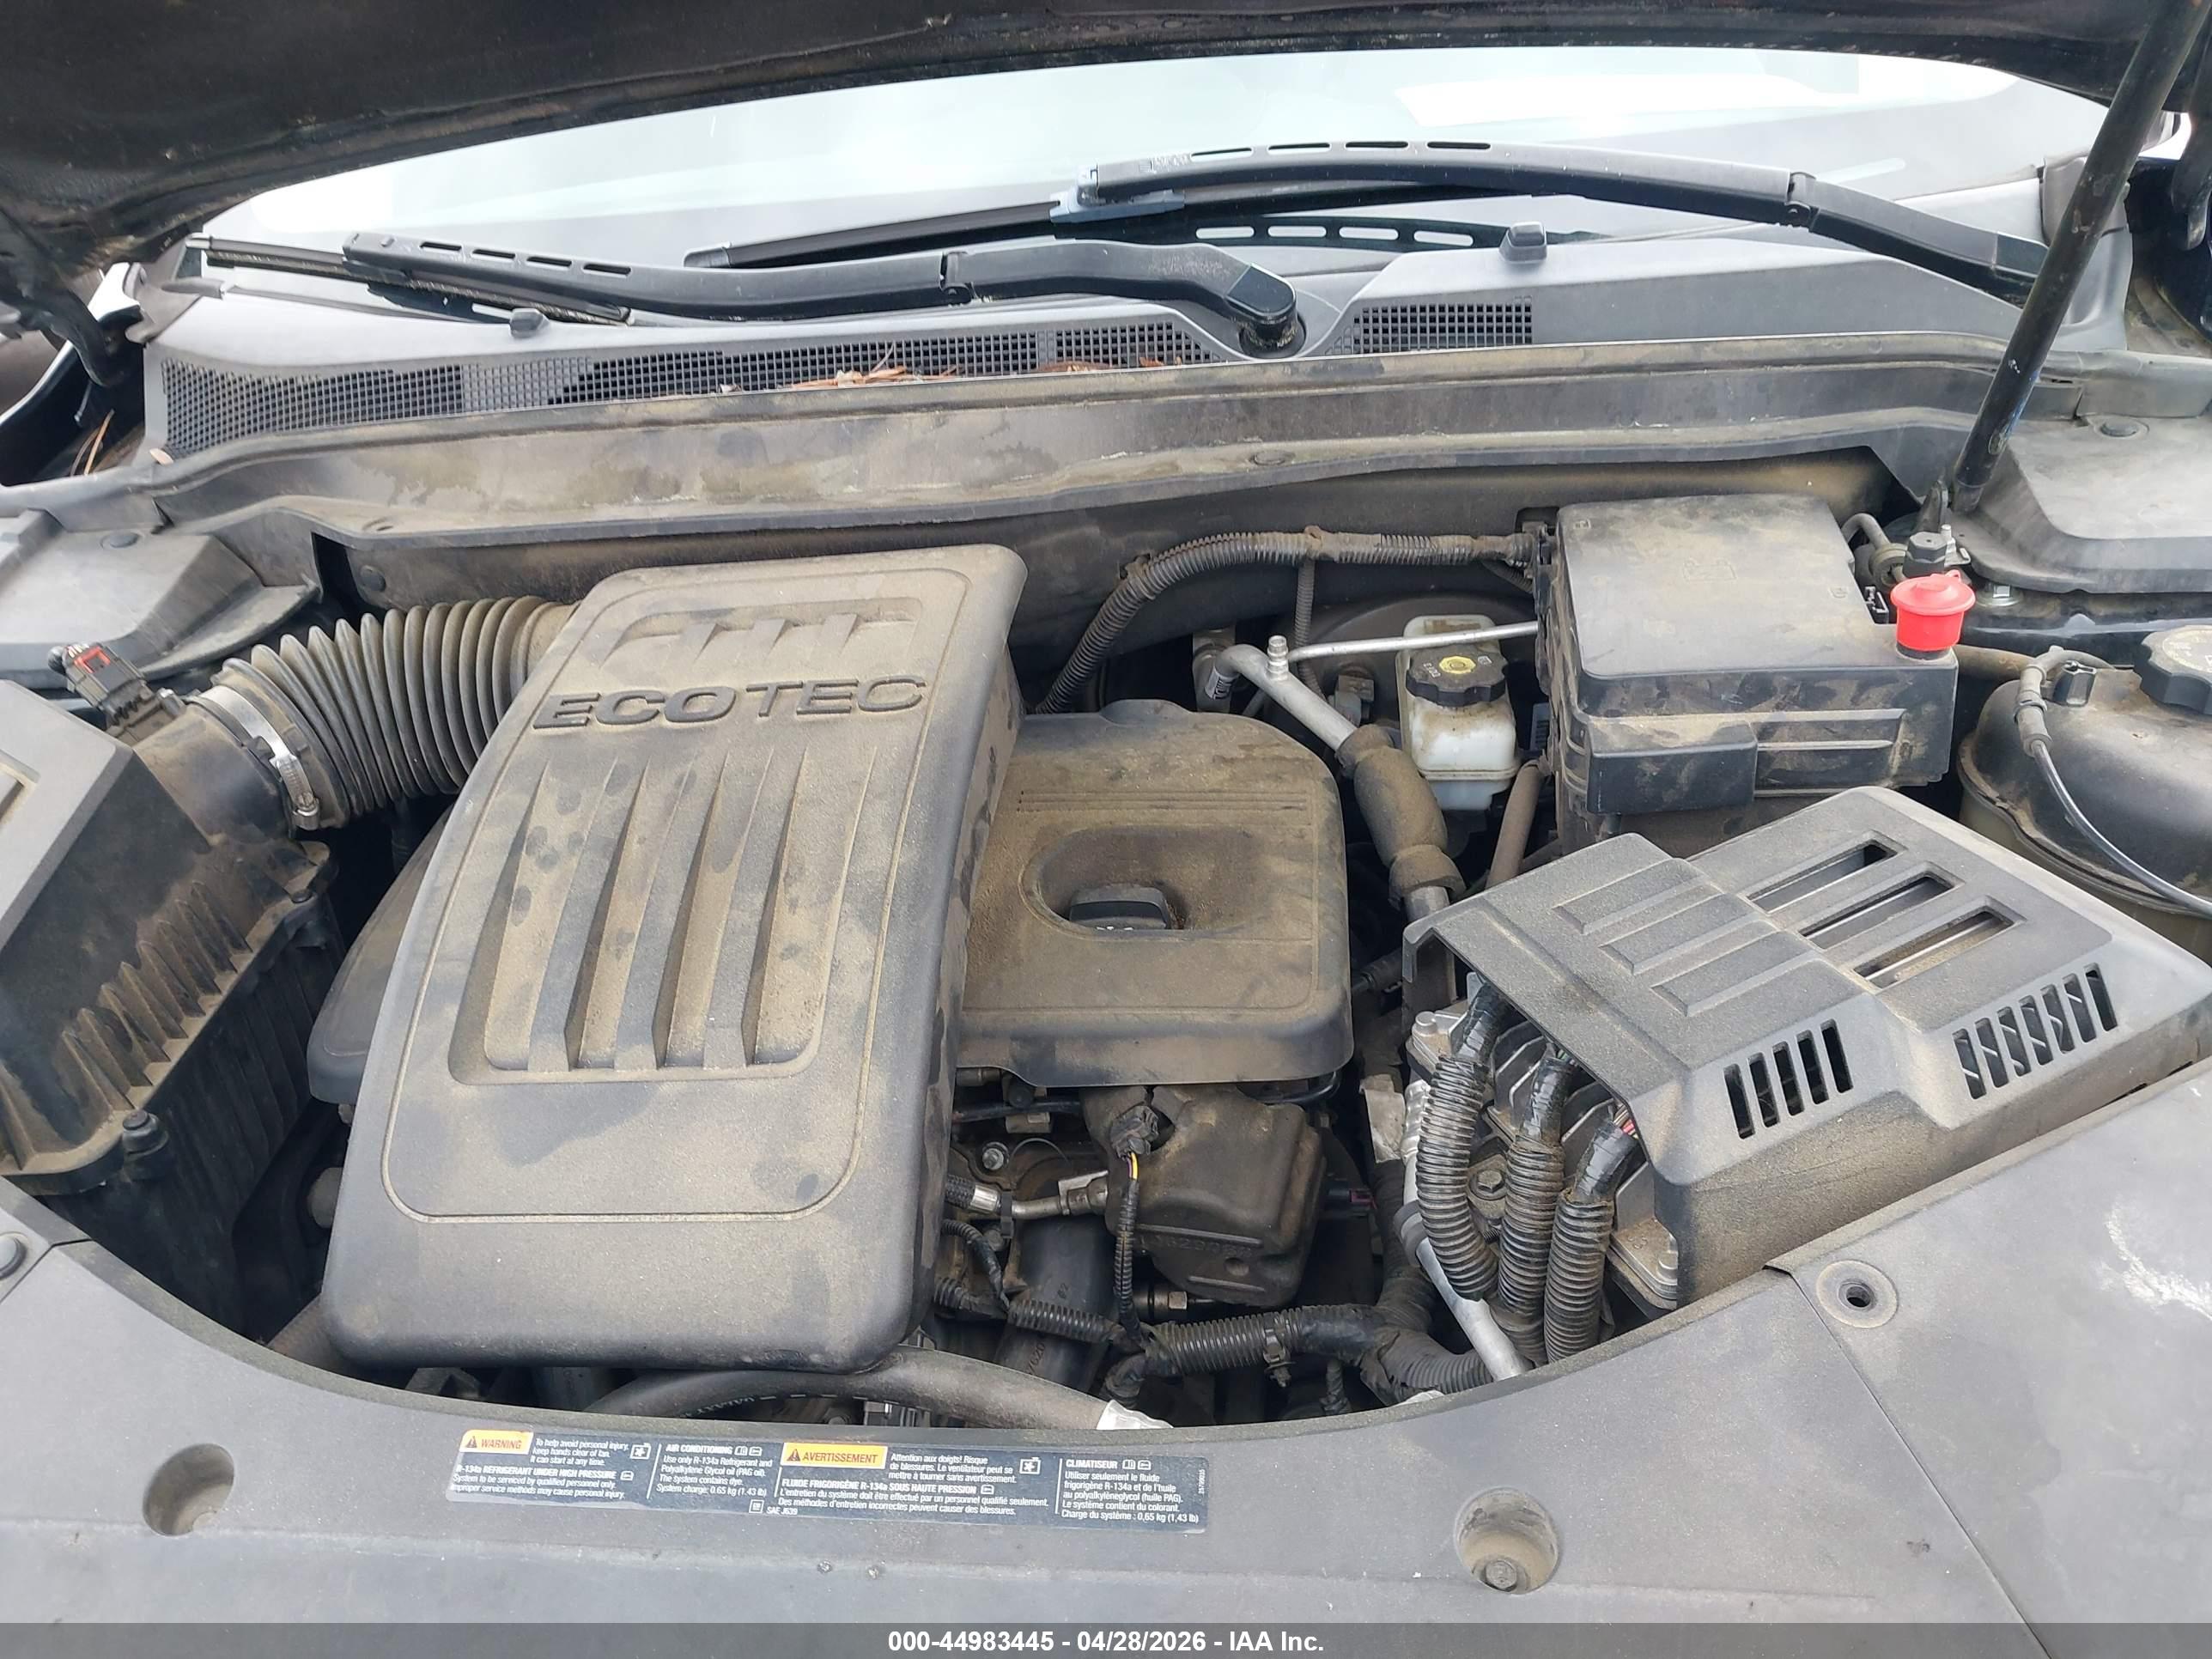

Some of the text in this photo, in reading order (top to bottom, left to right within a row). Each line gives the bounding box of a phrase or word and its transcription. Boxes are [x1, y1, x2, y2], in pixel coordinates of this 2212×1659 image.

[532, 673, 927, 729] ECOTEC
[481, 1438, 522, 1449] WARNING
[680, 1444, 733, 1455] CONDITIONING
[663, 1455, 773, 1468] Use only R-134a Refrigerant and
[802, 1451, 878, 1464] AVERTISSEMENT
[890, 1453, 922, 1462] Attention
[938, 1455, 963, 1464] doigts!
[963, 1455, 989, 1465] Risque
[660, 1464, 766, 1478] Polyalkylene Glycol oil (PAG oil).
[900, 1462, 935, 1471] blessures.
[937, 1463, 947, 1472] Le
[947, 1464, 986, 1474] ventilateur
[987, 1465, 1003, 1474] peut
[1066, 1460, 1118, 1469] CLIMATISEUR
[659, 1474, 743, 1486] The system contains dye.
[919, 1472, 945, 1480] tourner
[964, 1474, 1017, 1484] avertissement.
[1065, 1470, 1091, 1480] Utiliser
[1091, 1472, 1129, 1481] seulement
[1139, 1473, 1160, 1482] fluide
[656, 1483, 682, 1493] System
[683, 1485, 708, 1495] charge:
[727, 1486, 737, 1496] kg
[738, 1487, 757, 1497] (1.43
[757, 1488, 767, 1498] lb)
[781, 1479, 976, 1494] FLUIDE FRIGORIGÈNE R-134a SOUS HAUTE PRESSION
[1064, 1480, 1176, 1493] frigorigène R-134a et de l'huile
[780, 1487, 817, 1498] L'entretien
[828, 1491, 858, 1499] système
[874, 1492, 889, 1501] être
[945, 1496, 980, 1504] personnel
[981, 1496, 1008, 1504] qualifié
[1009, 1497, 1049, 1506] seulement.
[1073, 1491, 1140, 1502] polyalkylèneglycol
[1141, 1493, 1162, 1503] (huile
[1164, 1493, 1183, 1504] PAG).
[778, 1497, 793, 1506] Des
[793, 1498, 829, 1507] méthodes
[829, 1499, 867, 1509] d'entretien
[868, 1502, 908, 1511] incorrectes
[908, 1504, 939, 1512] peuvent
[964, 1505, 979, 1514] des
[980, 1505, 1017, 1515] blessures.
[1062, 1499, 1180, 1512] Le système contient du colorant.
[1061, 1509, 1088, 1520] Charge
[1089, 1510, 1099, 1519] du
[1100, 1511, 1132, 1521] système
[1137, 1512, 1155, 1522] 0,65
[1156, 1513, 1166, 1523] kg
[1167, 1513, 1188, 1523] (1,43
[1188, 1513, 1199, 1524] lb)
